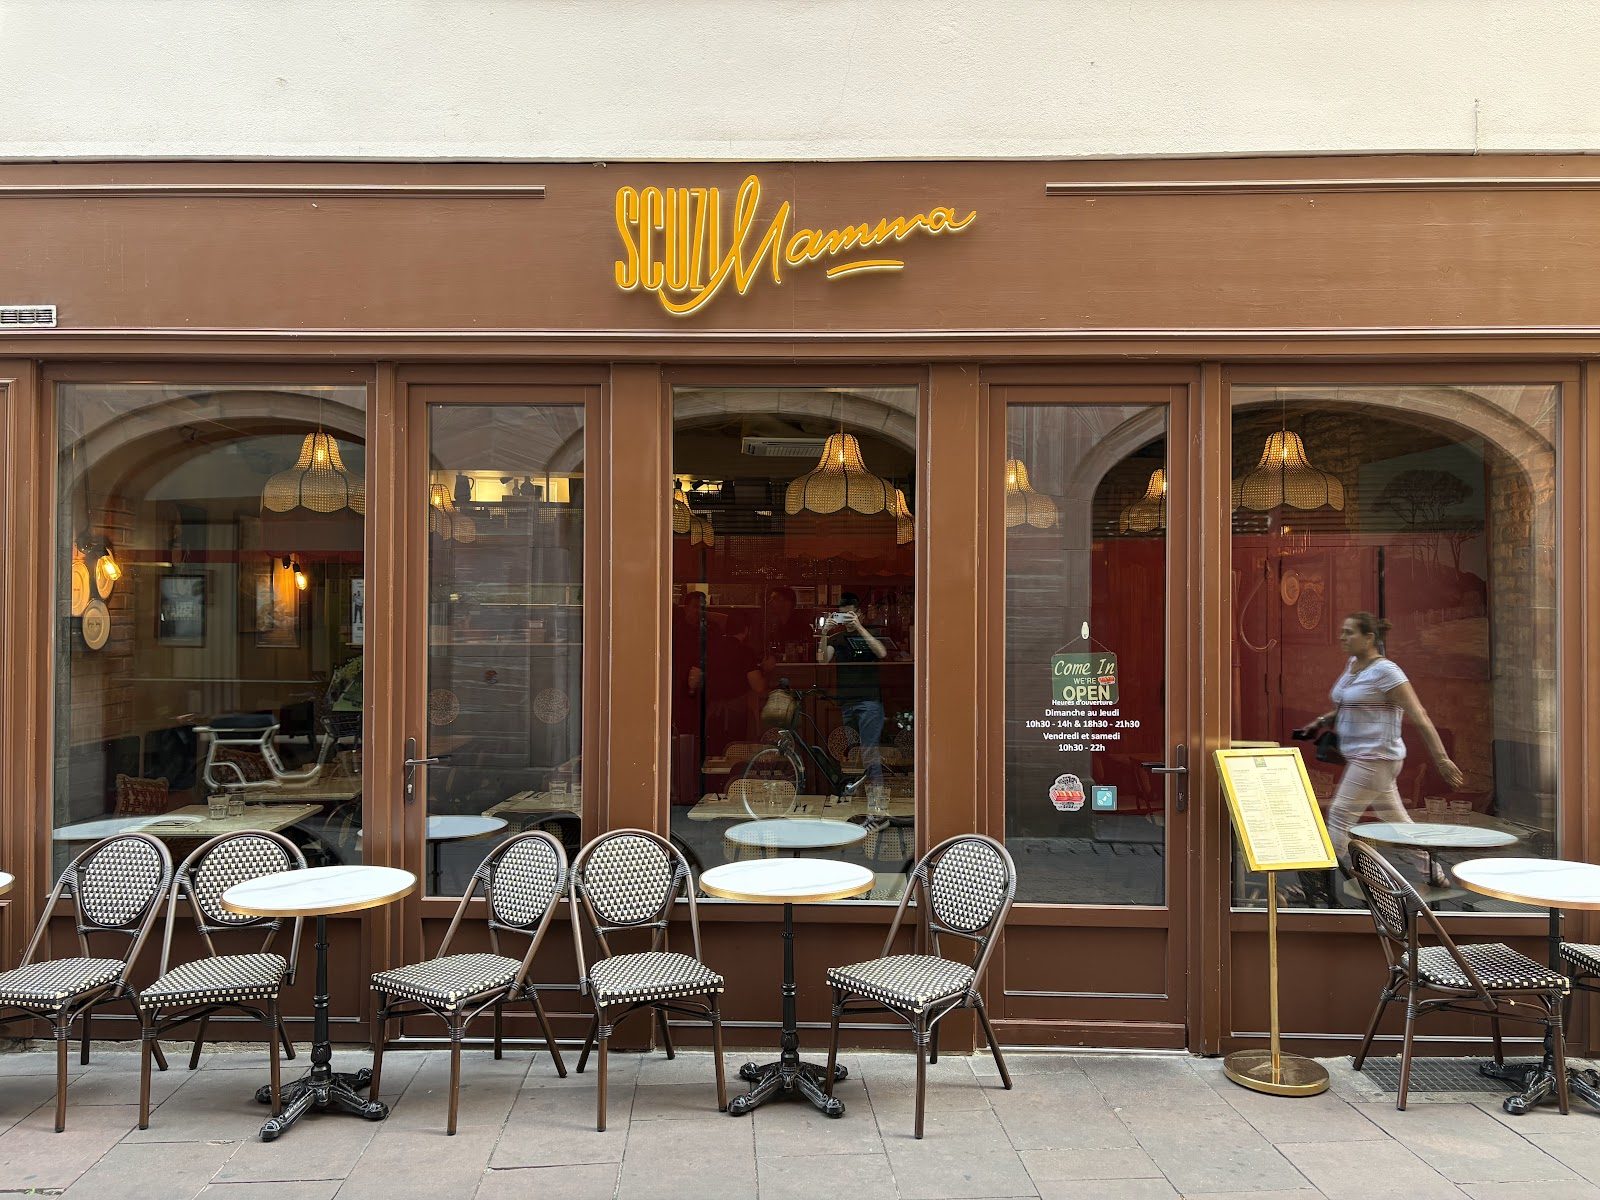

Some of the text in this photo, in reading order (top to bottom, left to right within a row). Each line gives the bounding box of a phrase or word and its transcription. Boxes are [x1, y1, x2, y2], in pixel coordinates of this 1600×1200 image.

[615, 174, 977, 315] SCUZI Mamma
[1054, 658, 1116, 676] Come In
[1073, 677, 1097, 685] WE'RE
[1062, 685, 1111, 701] OPEN
[1045, 708, 1086, 717] Dimanche
[1025, 720, 1051, 728] 10h30
[1057, 720, 1073, 728] 14h
[1074, 720, 1081, 728] &
[1083, 720, 1108, 728] 18h30
[1114, 720, 1140, 728] 21h30
[1043, 732, 1080, 740] Vendredi
[1091, 732, 1121, 740] samedi
[1058, 744, 1084, 752] 10h30
[1090, 744, 1106, 752] 22h
